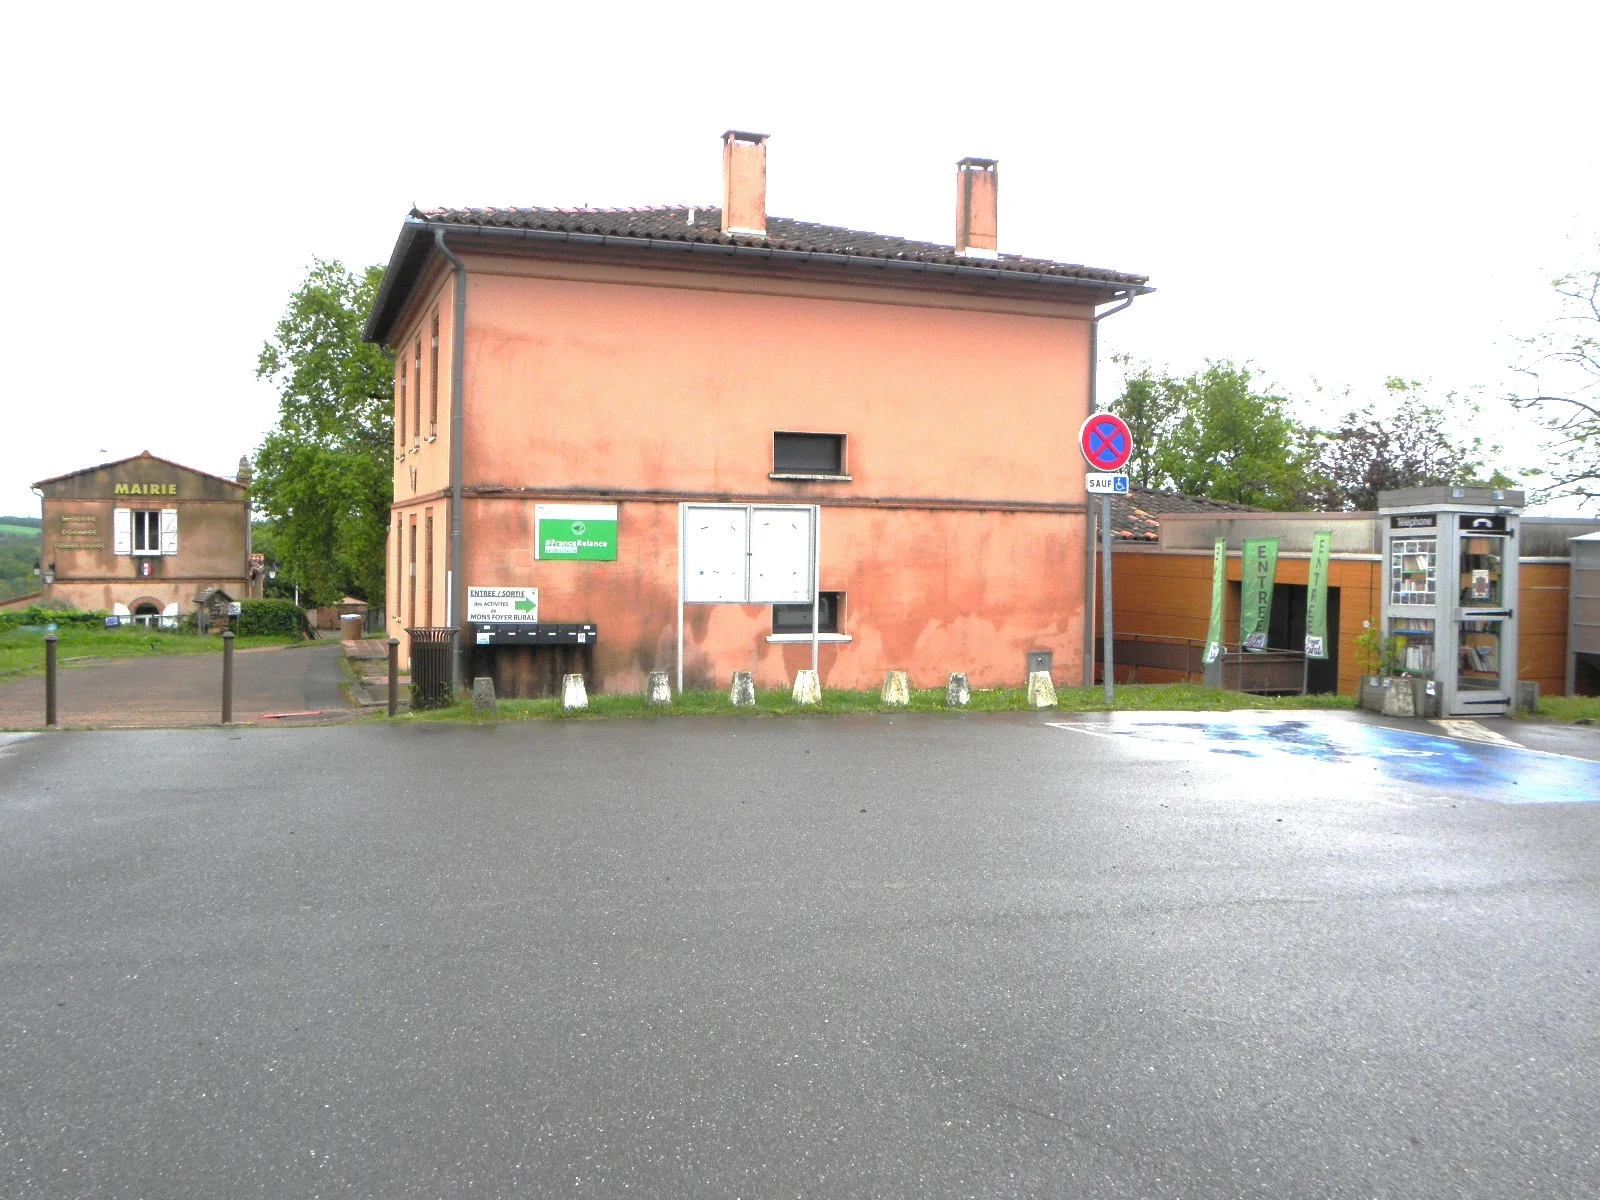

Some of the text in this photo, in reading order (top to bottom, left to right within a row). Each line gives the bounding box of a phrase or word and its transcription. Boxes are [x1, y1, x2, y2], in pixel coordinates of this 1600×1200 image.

[1089, 479, 1112, 487] SAUF
[114, 483, 177, 495] MAIRIE
[1396, 517, 1433, 528] Téléphone
[470, 590, 497, 598] ENTREE
[502, 590, 525, 598] SORTIE
[1255, 545, 1269, 632] ENTREE
